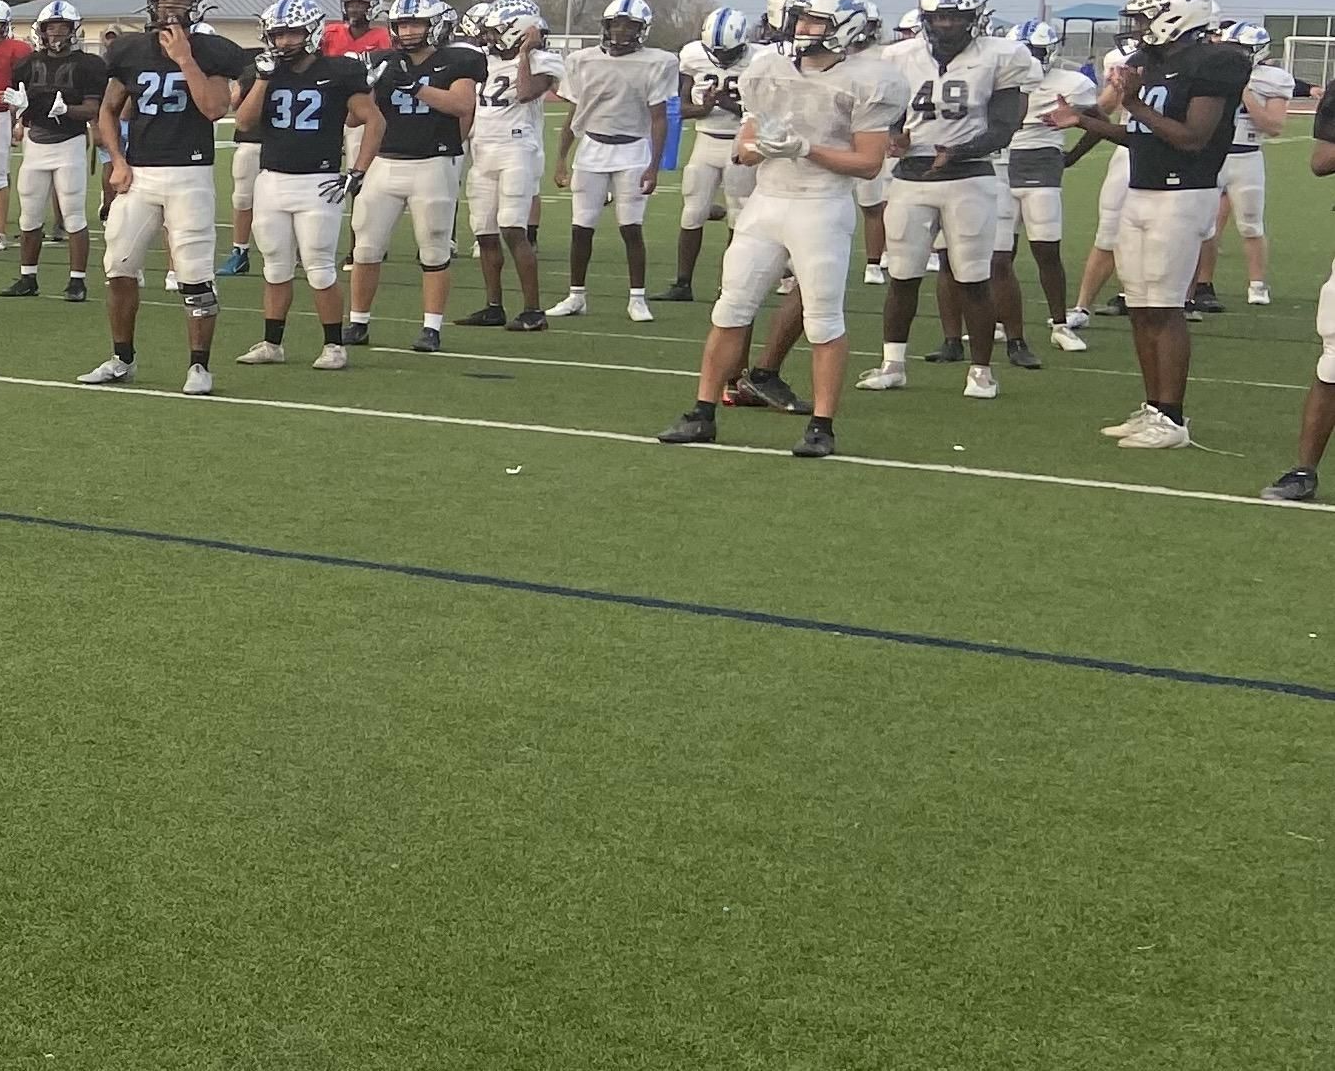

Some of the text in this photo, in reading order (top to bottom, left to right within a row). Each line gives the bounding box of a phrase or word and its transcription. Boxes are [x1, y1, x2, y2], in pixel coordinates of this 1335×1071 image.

[137, 71, 188, 116] 25
[271, 88, 322, 130] 32
[911, 80, 969, 120] 49
